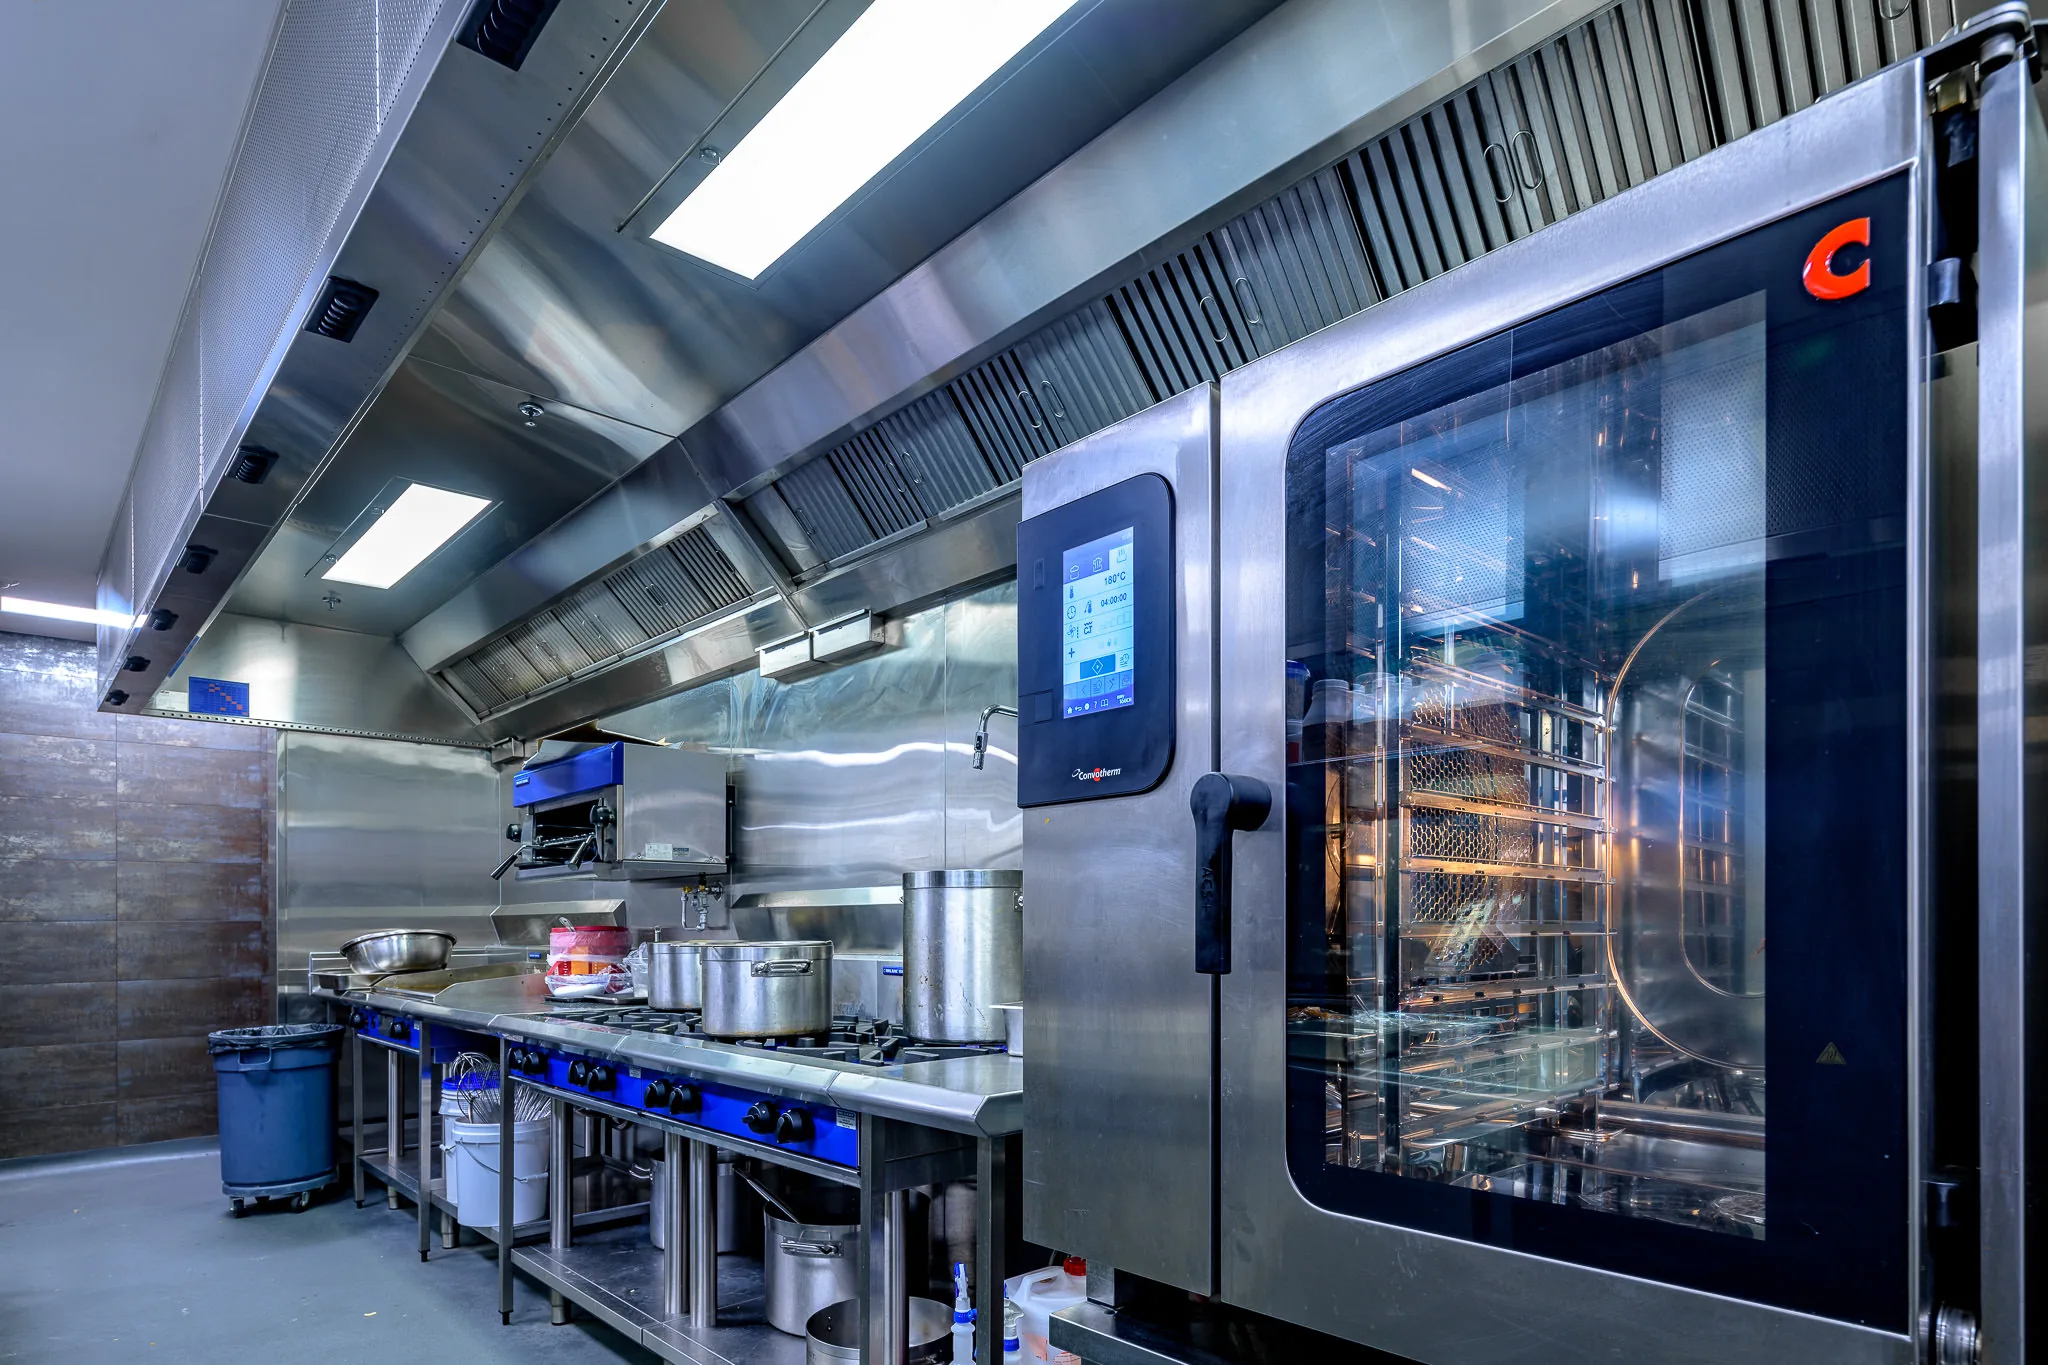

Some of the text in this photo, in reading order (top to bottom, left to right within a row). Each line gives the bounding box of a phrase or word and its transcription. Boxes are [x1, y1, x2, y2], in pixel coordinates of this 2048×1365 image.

[1803, 217, 1871, 300] C
[1104, 571, 1126, 585] 180°C
[1100, 592, 1127, 607] 04:00:00
[1078, 767, 1121, 781] Convotherm
